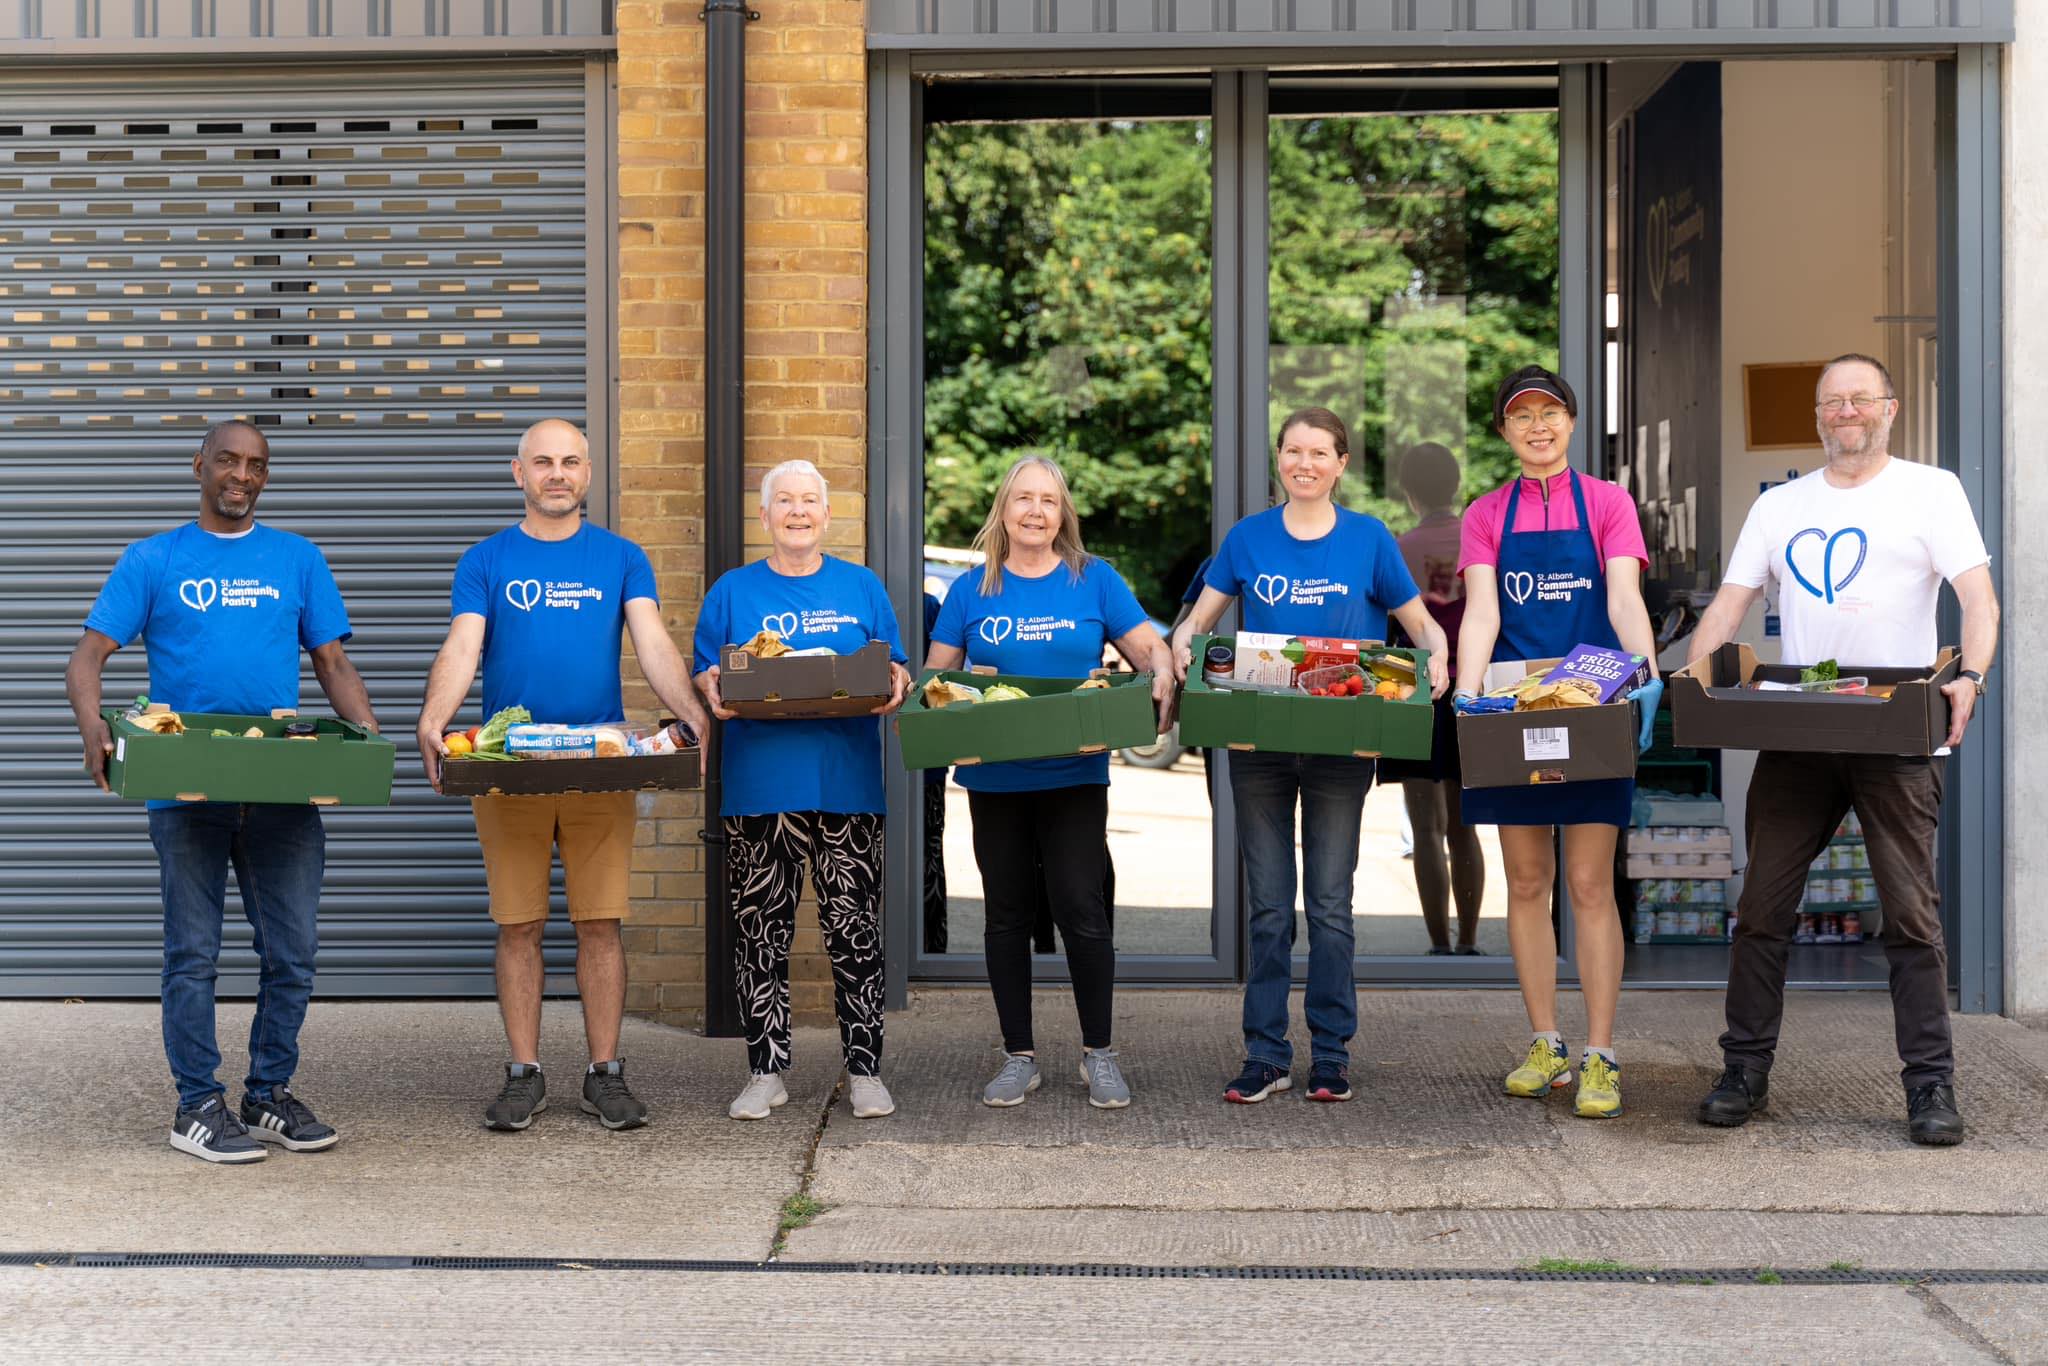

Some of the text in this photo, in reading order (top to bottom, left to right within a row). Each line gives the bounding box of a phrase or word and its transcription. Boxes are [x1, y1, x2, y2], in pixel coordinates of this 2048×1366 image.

[1548, 572, 1573, 580] Albans
[232, 578, 259, 586] Albans
[1304, 578, 1329, 586] Albans
[1537, 577, 1592, 590] Community
[221, 586, 279, 599] Community
[545, 588, 602, 600] Community
[1291, 583, 1348, 595] Community
[1290, 595, 1324, 605] Pantry
[1538, 591, 1571, 602] Pantry
[222, 597, 257, 608] Pantry
[545, 598, 579, 610] Pantry
[802, 615, 858, 626] Community
[1016, 619, 1075, 631] Community
[803, 623, 838, 634] Pantry
[1016, 631, 1052, 641] Pantry
[1577, 654, 1625, 670] FRUIT
[1563, 662, 1577, 670] &
[1577, 663, 1623, 680] FIBRE
[508, 735, 552, 747] Warburtons
